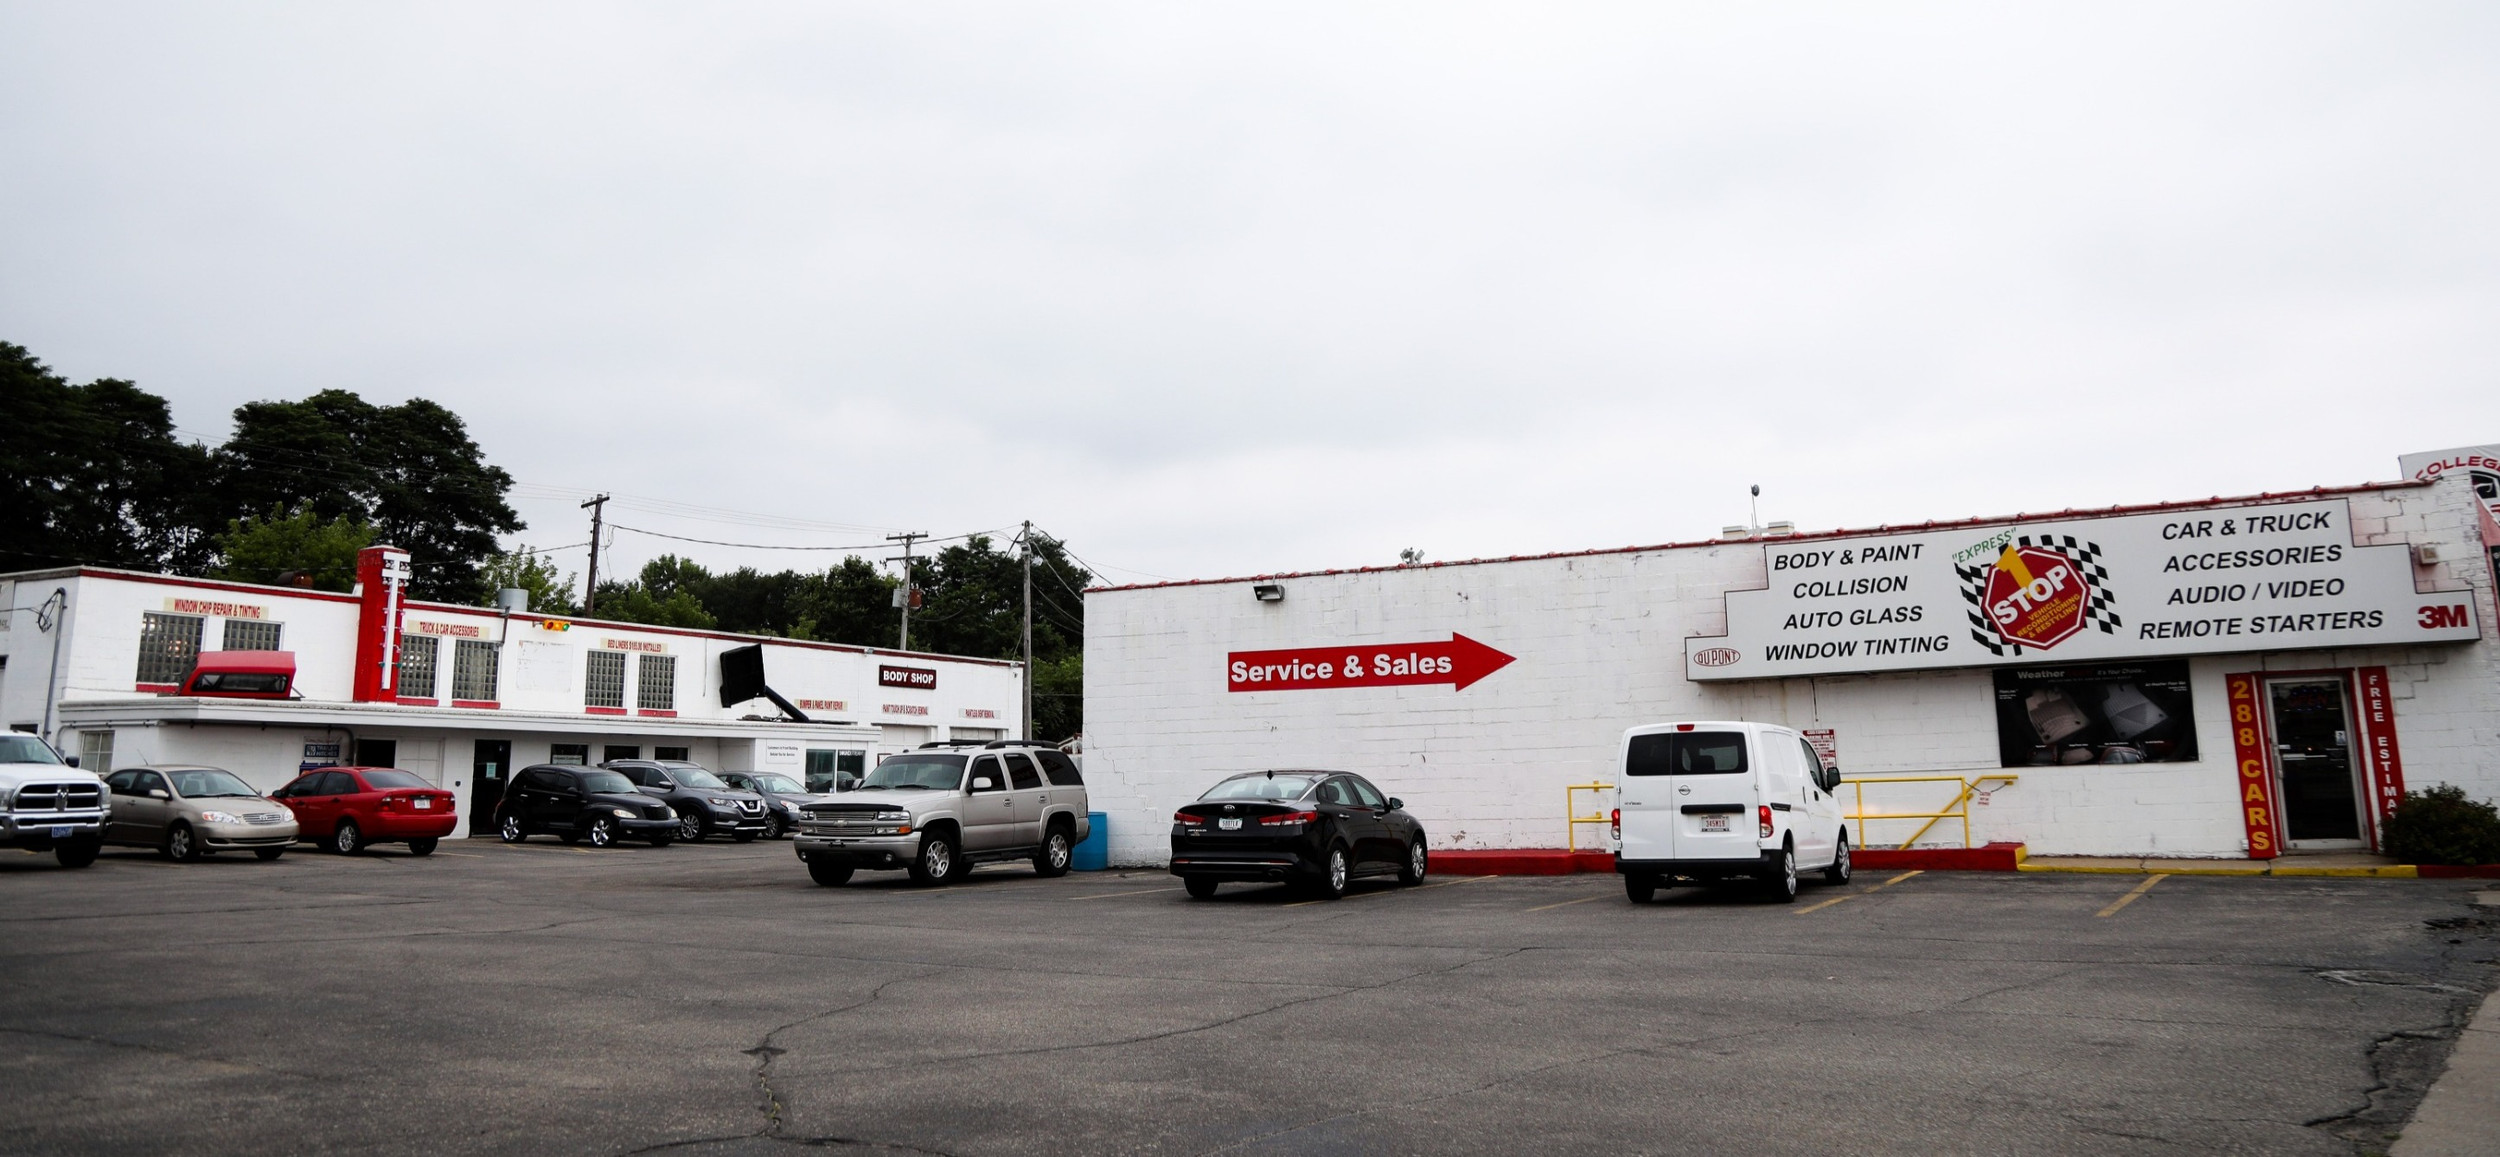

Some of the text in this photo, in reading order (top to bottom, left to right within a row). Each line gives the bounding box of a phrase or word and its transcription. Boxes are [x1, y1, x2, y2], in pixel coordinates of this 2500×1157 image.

[2416, 456, 2500, 479] OLLEG
[2162, 511, 2332, 540] CAR & TRUCK
[1774, 543, 1924, 571] BODY & PAINT
[2163, 544, 2342, 573] ACCESSORIES
[1995, 544, 2040, 600] 1
[1793, 575, 1908, 599] COLLISION
[1993, 565, 2068, 625] STOP
[2167, 578, 2345, 605] AUDIO / VIDEO
[174, 599, 260, 618] WINDOW CHIP REPAIR & TINTING
[1783, 605, 1923, 630] AUTO GLASS
[2017, 594, 2080, 638] RECONDITIONING
[2028, 597, 2061, 621] VEHICLE
[2029, 604, 2078, 639] & RESTYLING
[2418, 605, 2469, 629] 3M
[420, 621, 435, 634] TRUCK
[440, 624, 449, 635] CAR
[450, 624, 479, 637] ACCESSORIES
[2139, 610, 2384, 640] REMOTE STARTERS
[1765, 635, 1949, 661] WINDOW TINTING
[883, 670, 934, 685] BODY SHOP
[1231, 652, 1453, 683] Service & Sales
[2369, 675, 2385, 722] FREE
[2232, 680, 2270, 850] 288 CARS
